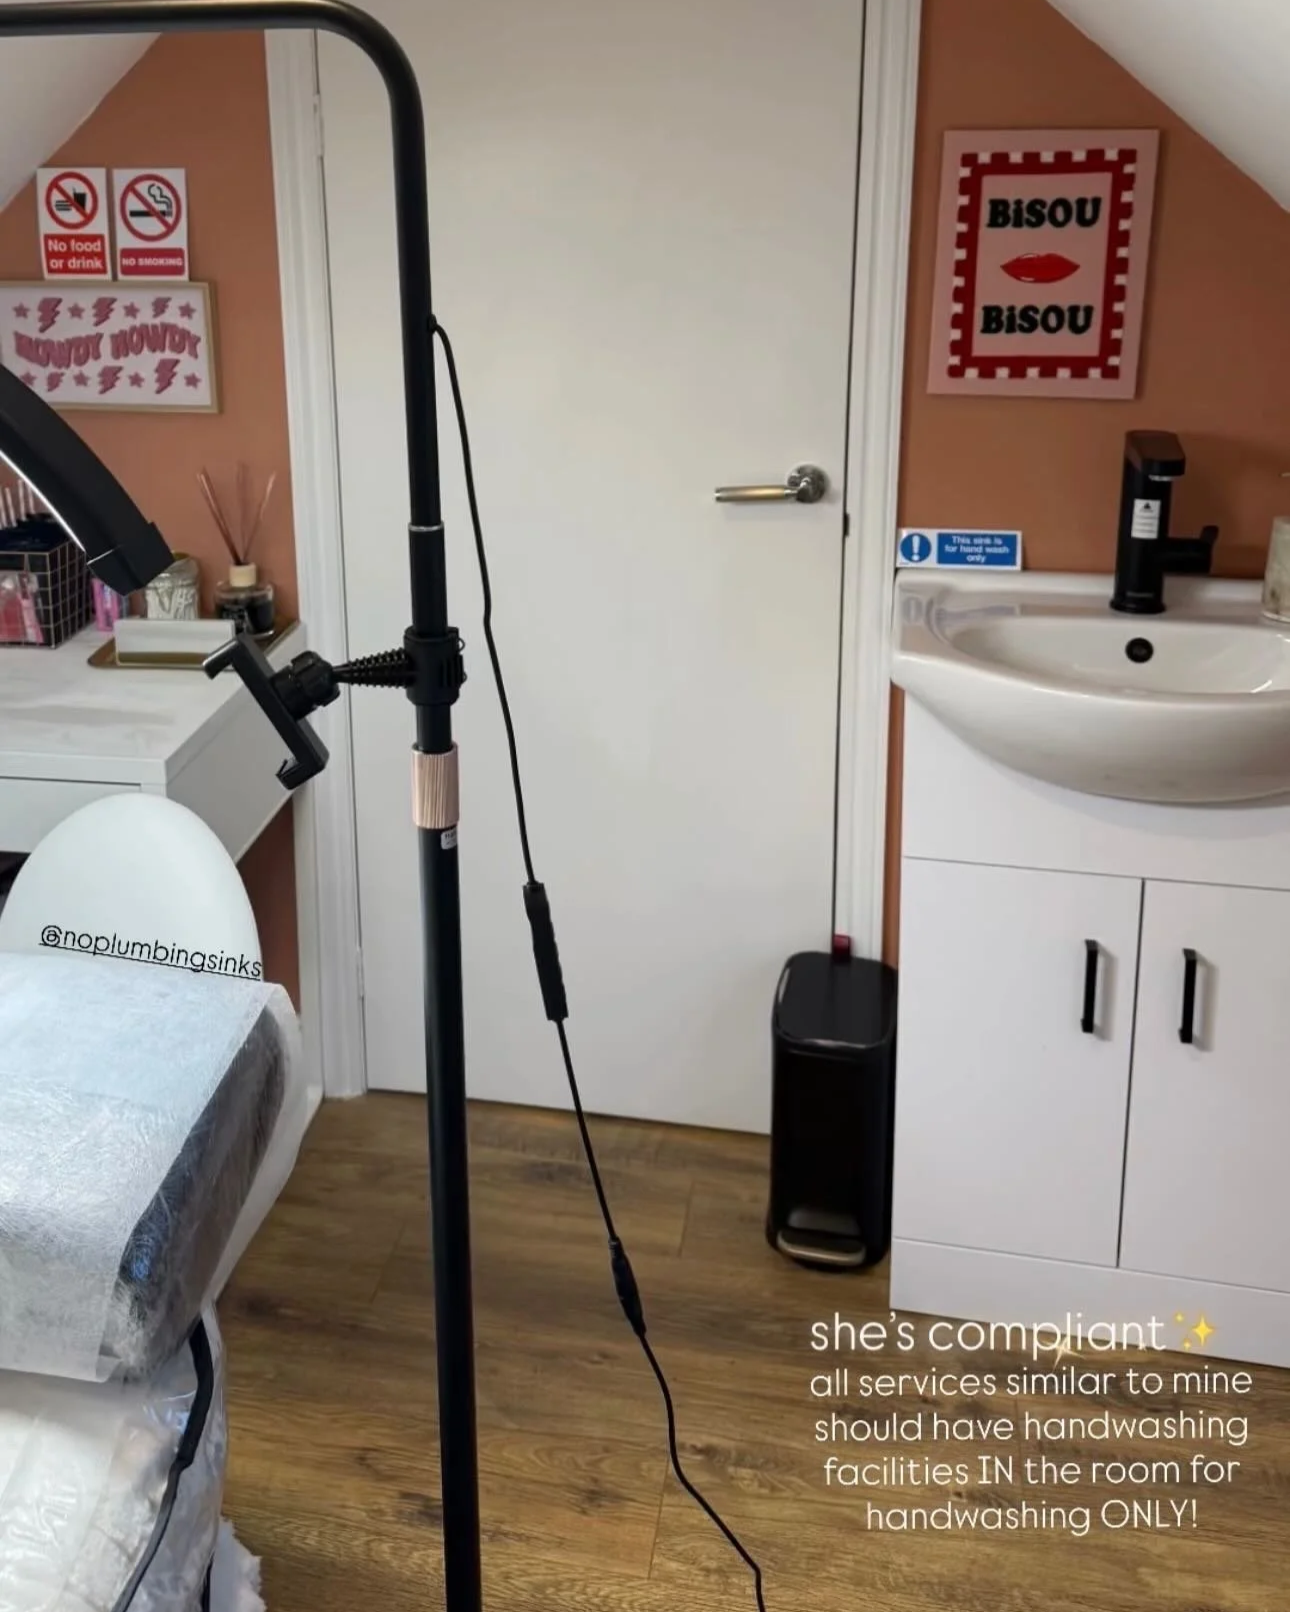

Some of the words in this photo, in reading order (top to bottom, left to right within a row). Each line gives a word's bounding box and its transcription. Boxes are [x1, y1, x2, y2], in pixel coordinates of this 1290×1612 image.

[48, 239, 67, 252] No
[70, 239, 102, 252] food
[50, 258, 65, 269] or
[68, 254, 103, 270] drink
[121, 257, 136, 267] NO
[138, 257, 183, 267] SMOKING
[109, 322, 201, 360] HOWDY
[952, 535, 971, 544] This
[973, 535, 992, 545] sink
[994, 536, 1003, 545] is
[944, 545, 957, 553] for
[960, 544, 983, 554] hand
[985, 545, 1009, 554] wash
[966, 553, 987, 563] only
